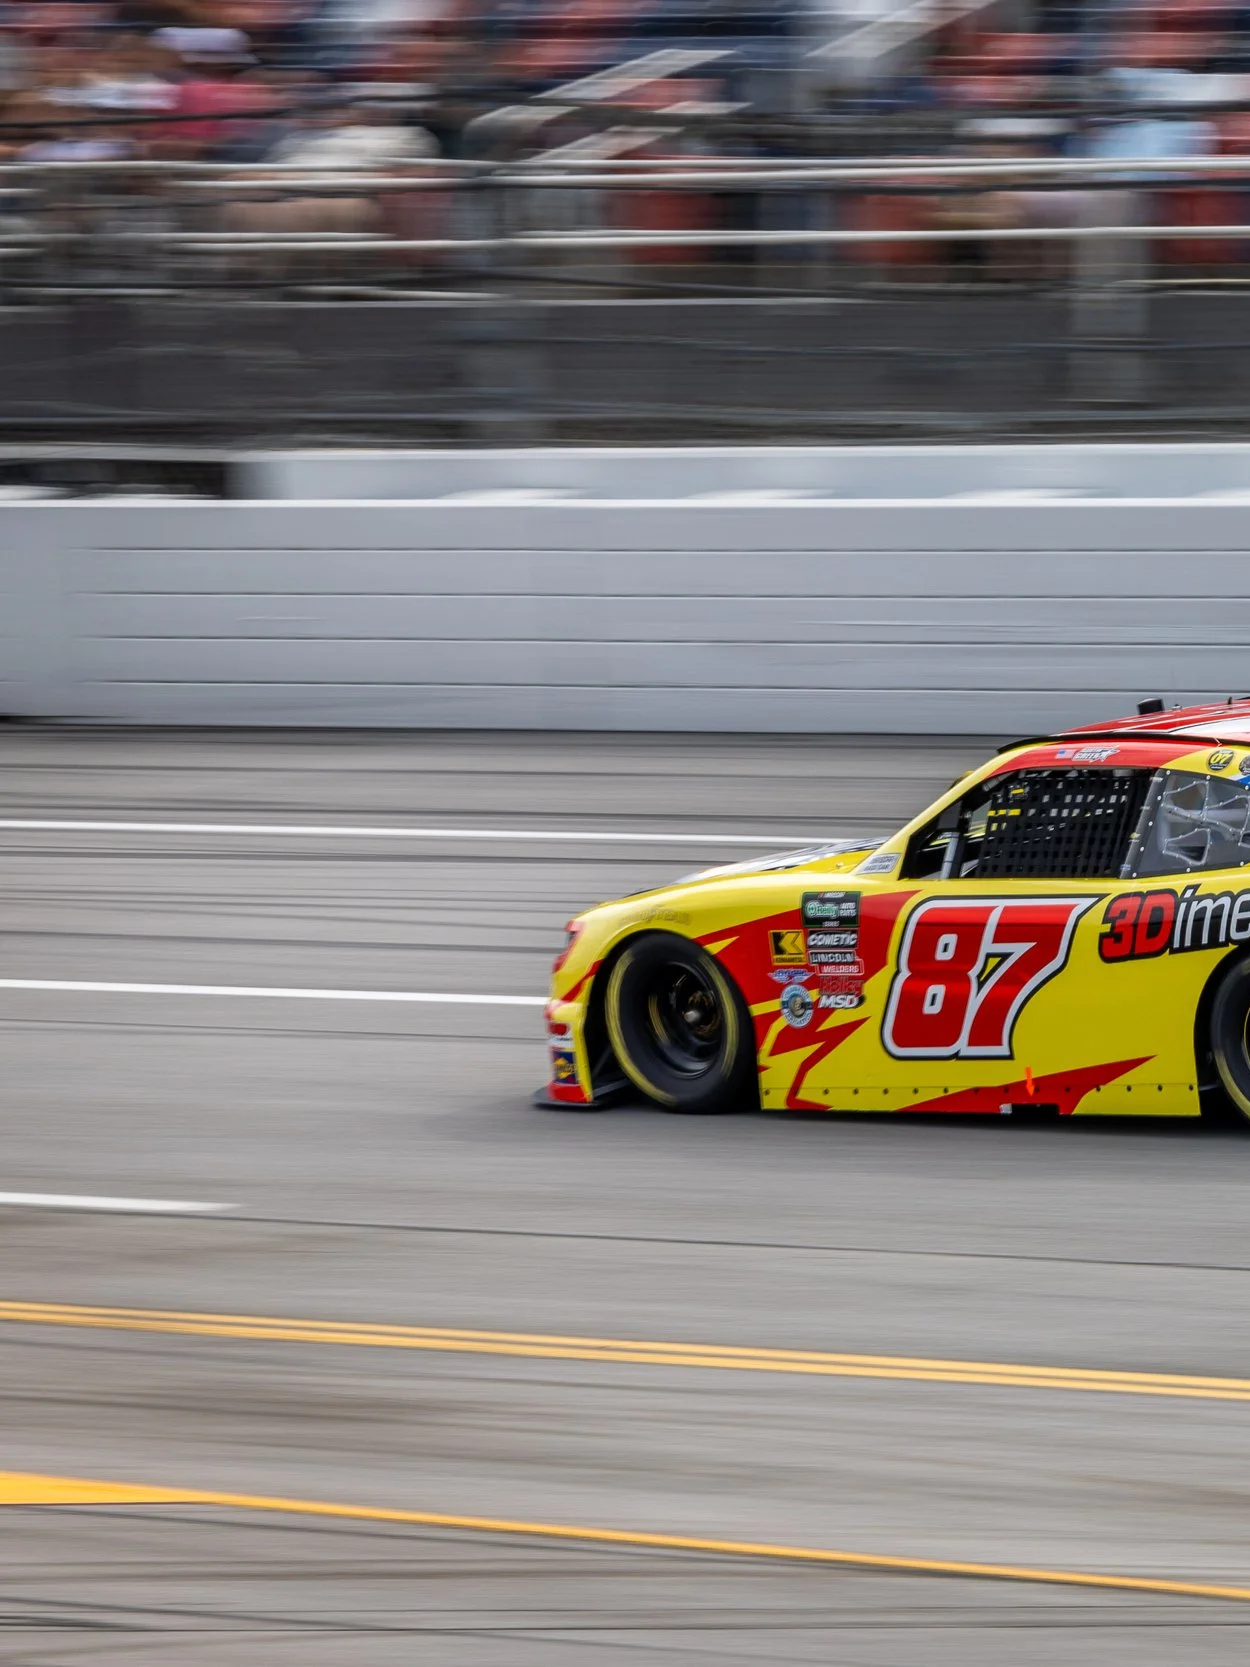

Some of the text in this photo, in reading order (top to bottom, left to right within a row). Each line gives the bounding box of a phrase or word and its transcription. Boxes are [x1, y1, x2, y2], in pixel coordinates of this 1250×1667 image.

[807, 933, 857, 946] COMETIC
[810, 953, 853, 963] LINCOLN
[822, 965, 860, 973] WELDERS
[884, 896, 1103, 1057] 87
[818, 994, 860, 1008] MSD
